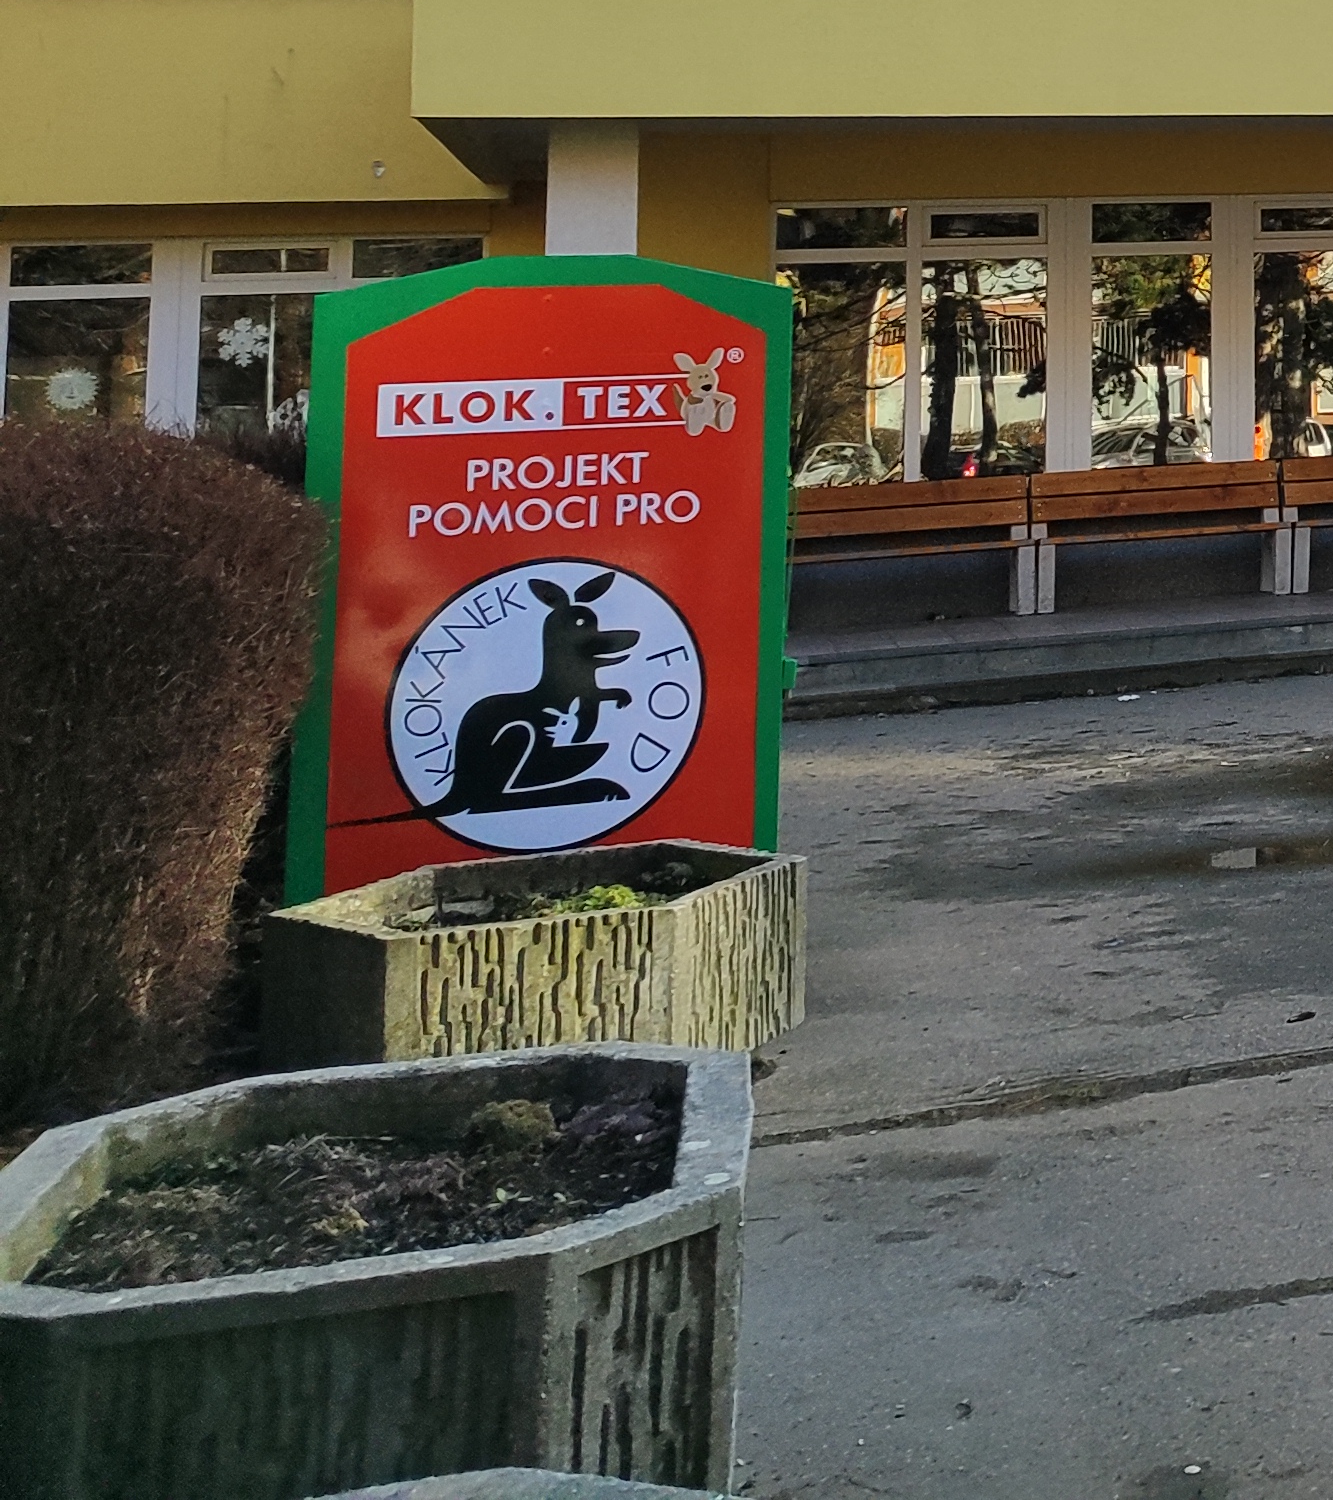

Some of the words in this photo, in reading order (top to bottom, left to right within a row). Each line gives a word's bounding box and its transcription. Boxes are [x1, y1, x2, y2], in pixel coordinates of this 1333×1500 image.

[577, 384, 668, 419] TEX
[466, 451, 650, 492] PROJEKT
[408, 495, 599, 538] POMOCI
[615, 490, 701, 526] PRO
[403, 582, 528, 787] KLOKÁNEK
[630, 645, 691, 773] FOD
